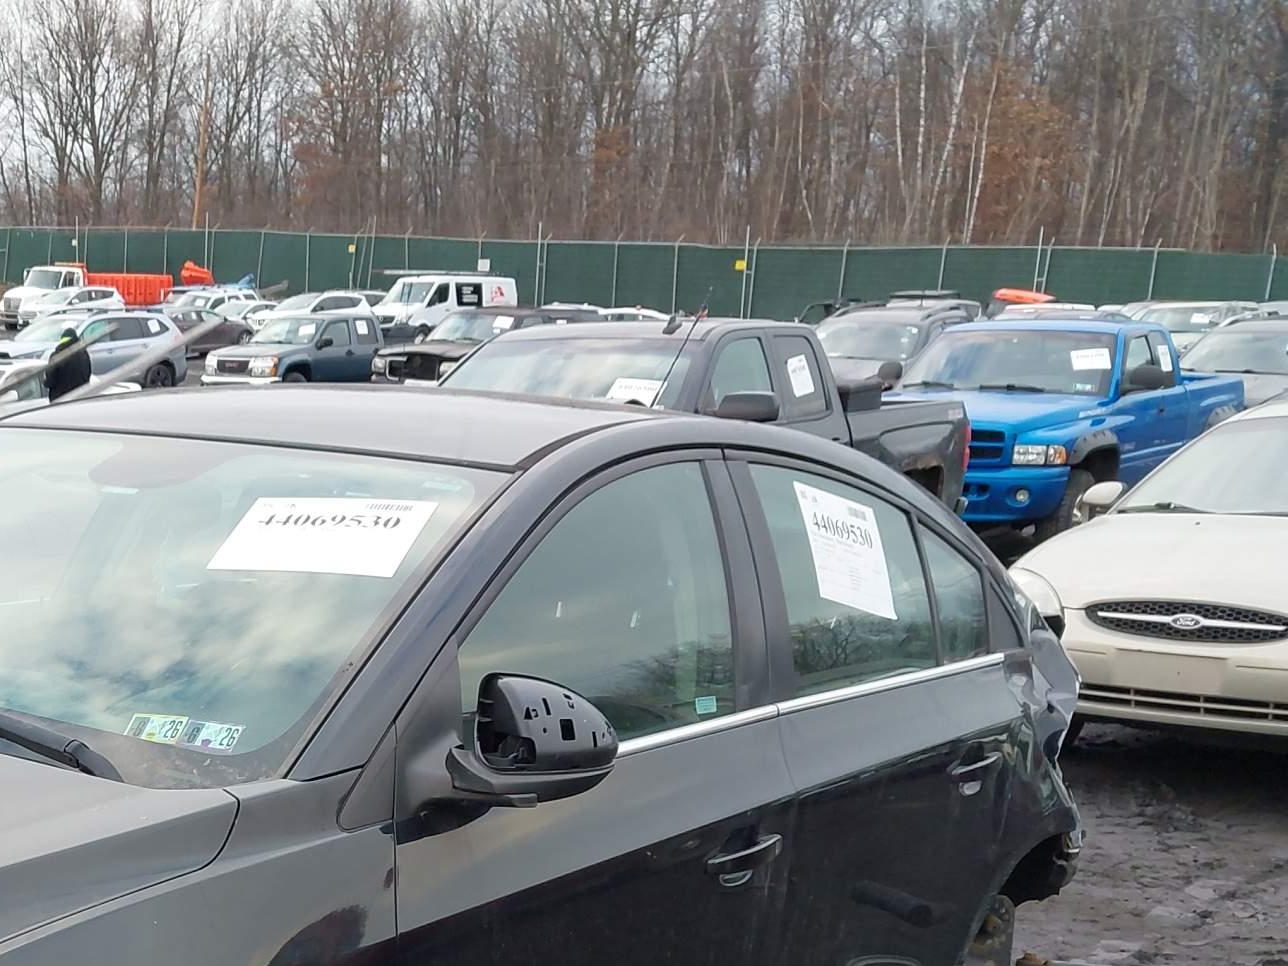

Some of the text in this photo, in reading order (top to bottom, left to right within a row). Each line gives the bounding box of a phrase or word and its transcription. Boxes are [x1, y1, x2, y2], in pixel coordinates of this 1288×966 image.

[258, 513, 402, 530] 44069530
[812, 511, 873, 549] 44069530
[163, 720, 184, 739] 26
[218, 727, 240, 747] 26
